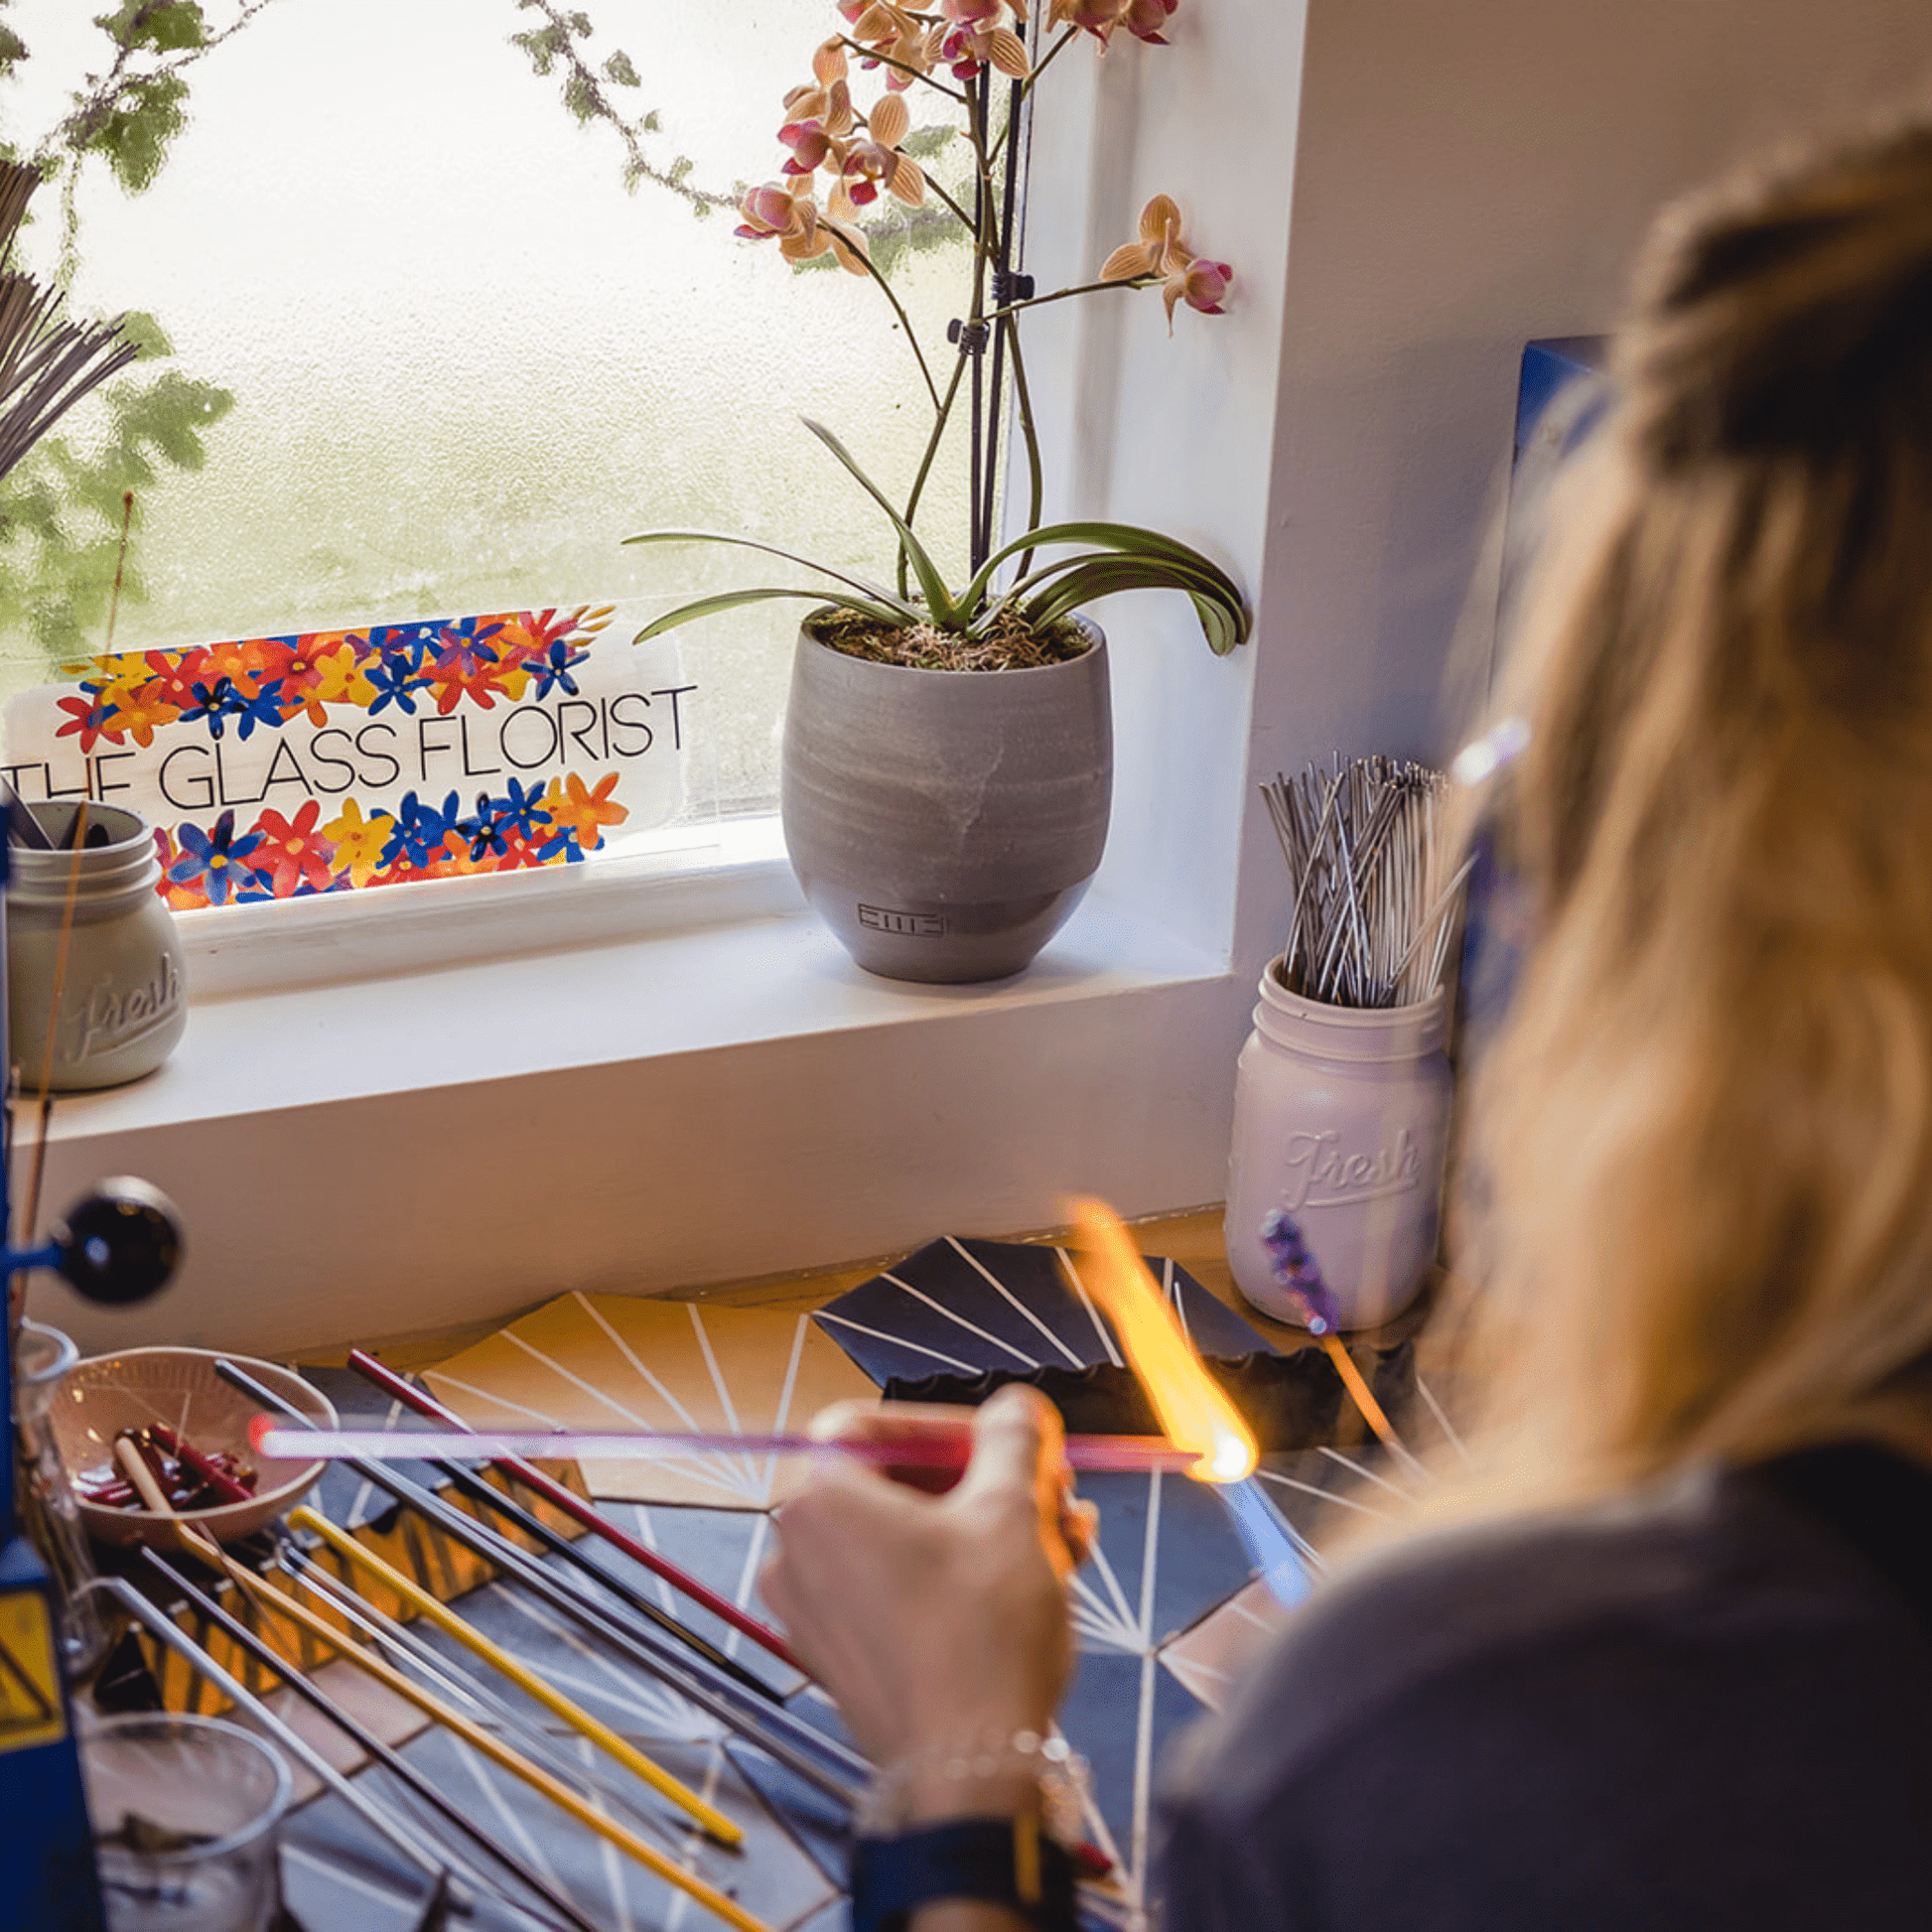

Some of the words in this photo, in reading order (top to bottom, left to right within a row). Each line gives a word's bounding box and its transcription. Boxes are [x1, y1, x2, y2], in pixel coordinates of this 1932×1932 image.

[159, 723, 400, 810] GLASS
[419, 685, 698, 781] FLORIST
[65, 951, 182, 1066] Fresh
[1284, 1129, 1420, 1213] Fresh
